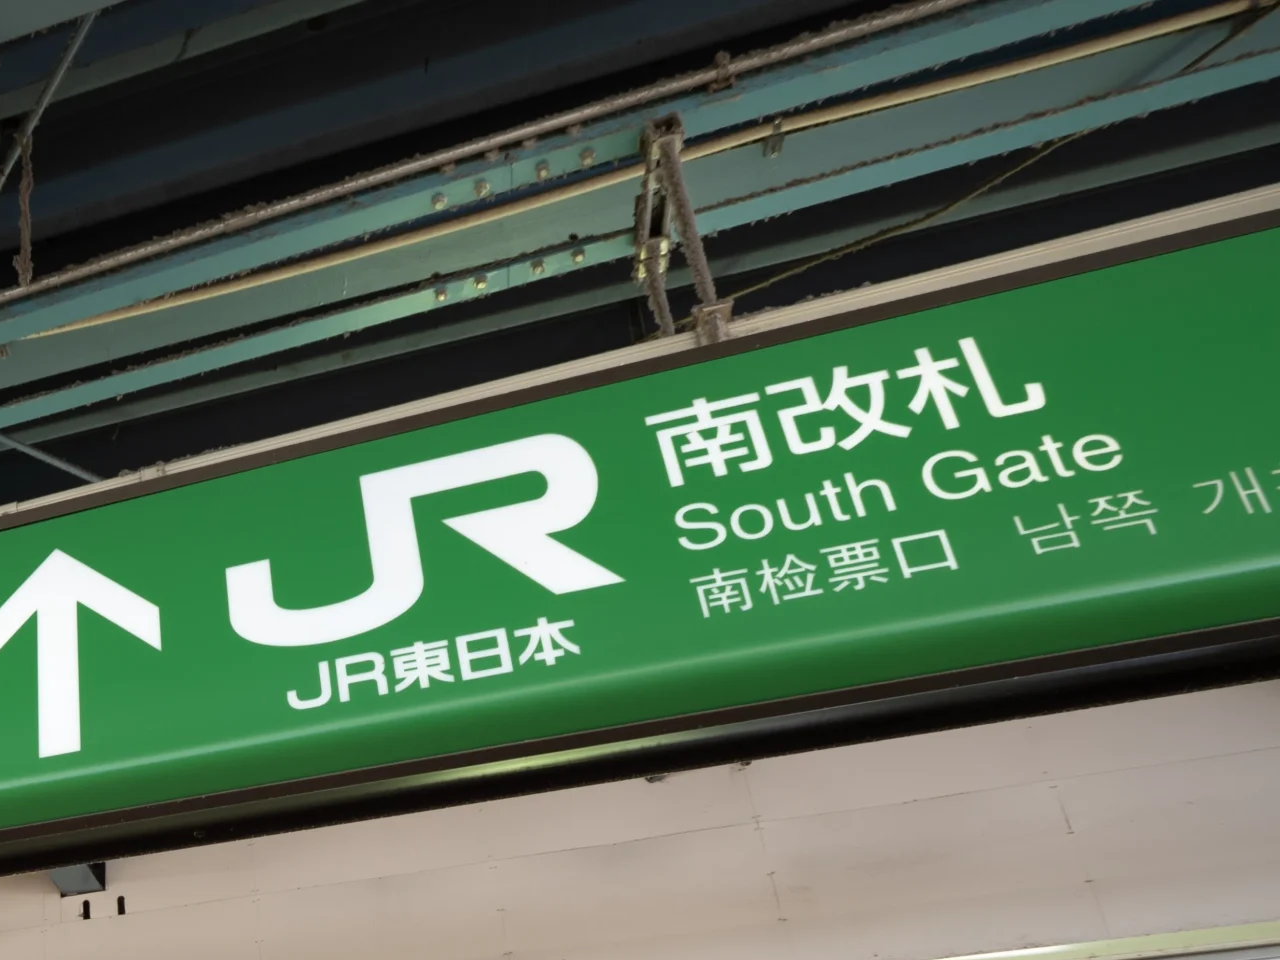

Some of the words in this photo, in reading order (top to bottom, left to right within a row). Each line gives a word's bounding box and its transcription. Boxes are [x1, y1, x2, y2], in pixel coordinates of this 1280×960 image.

[645, 336, 1047, 489] 南改札
[225, 433, 626, 647] JR
[673, 472, 897, 551] South
[922, 432, 1123, 501] Gate
[1013, 489, 1159, 556] 남쪽
[1192, 466, 1280, 516] 개
[690, 529, 959, 619] 南检票口
[286, 617, 581, 710] JR東日本
